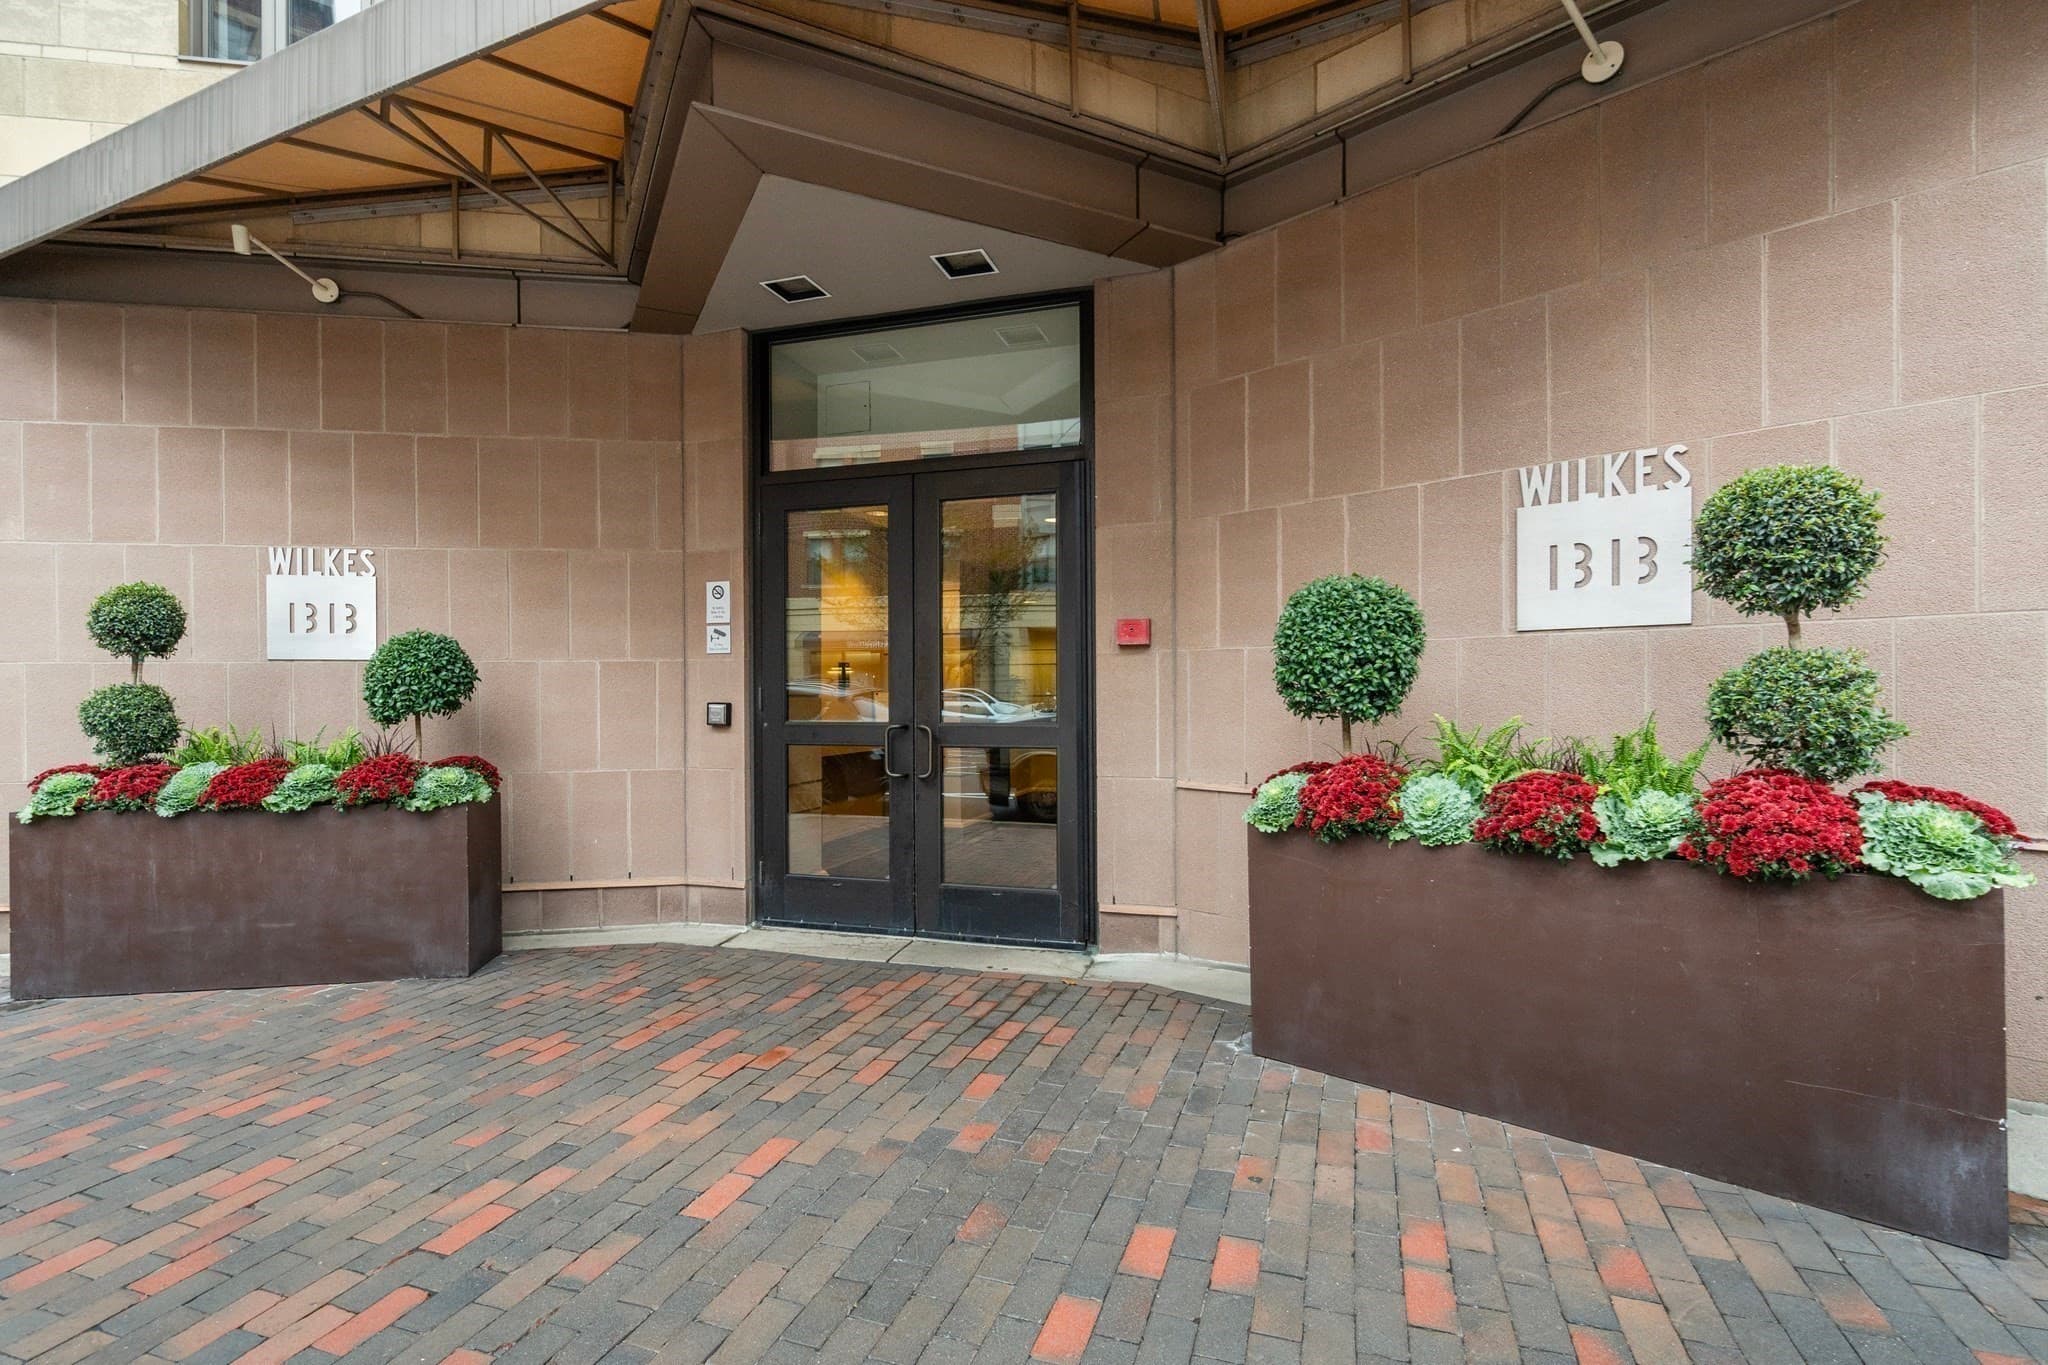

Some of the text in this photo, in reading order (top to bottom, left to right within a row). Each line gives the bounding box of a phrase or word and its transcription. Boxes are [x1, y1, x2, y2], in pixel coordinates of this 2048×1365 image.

[1518, 444, 1691, 508] WILKES
[268, 546, 376, 577] WILKES
[1549, 536, 1658, 591] 1313
[289, 602, 357, 634] 1313
